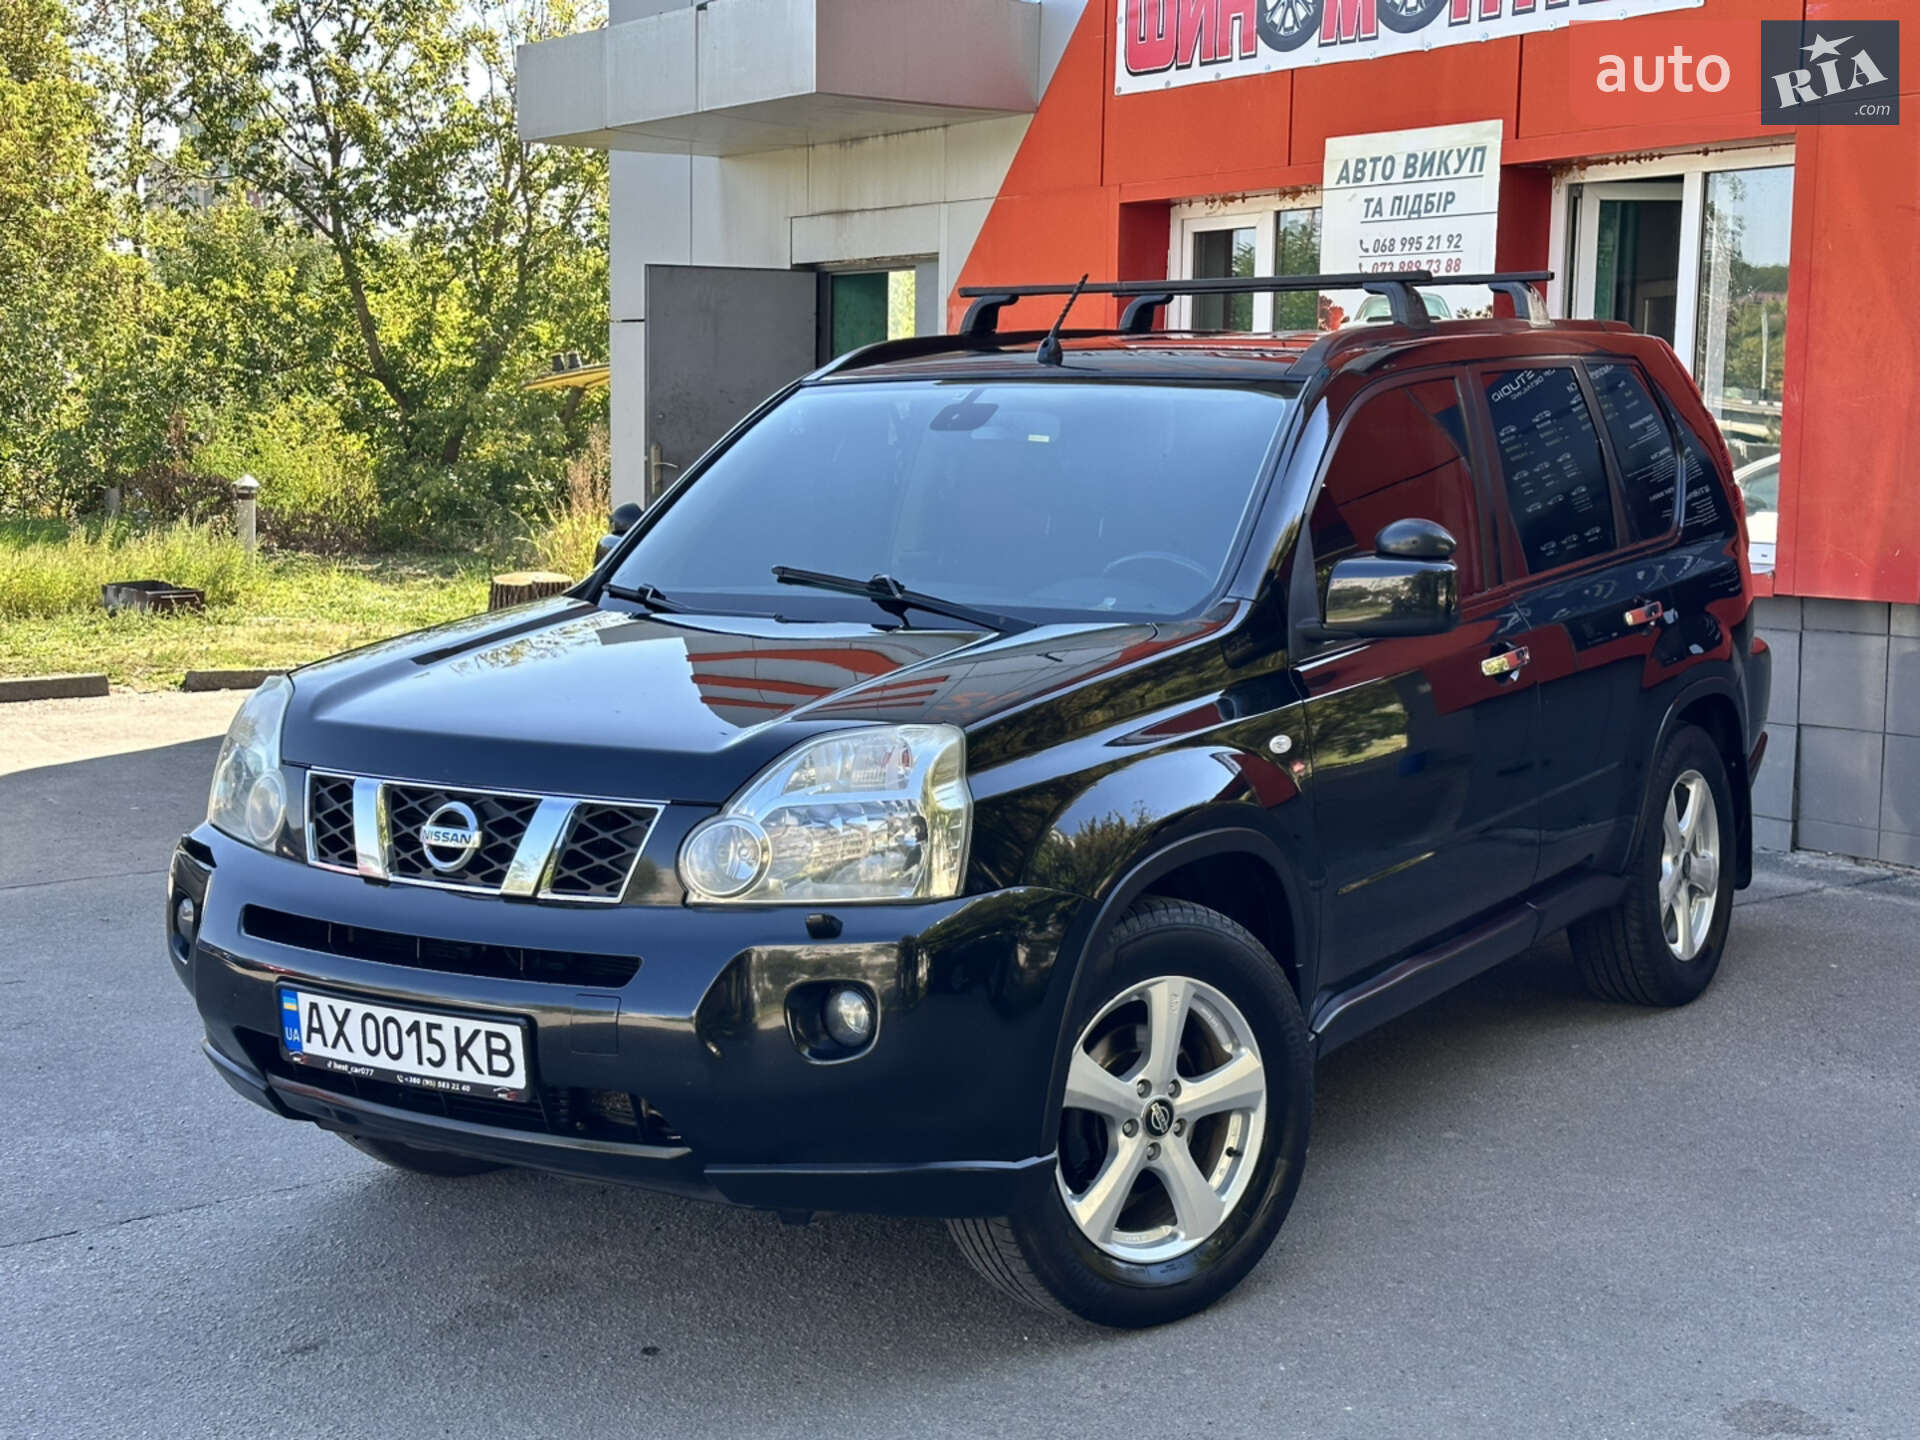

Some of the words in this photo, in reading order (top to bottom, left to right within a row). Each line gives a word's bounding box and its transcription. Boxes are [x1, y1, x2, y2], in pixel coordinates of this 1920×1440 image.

[1336, 155, 1396, 185] АВТО
[1402, 145, 1487, 180] ВИКУП
[1363, 197, 1383, 219] ТА
[1390, 191, 1456, 219] ПІДБІР
[1373, 238, 1396, 253] 068
[1400, 236, 1423, 252] 995
[1426, 234, 1442, 250] 21
[1447, 233, 1463, 249] 92
[1426, 259, 1441, 274] 73
[1445, 258, 1462, 273] 88
[423, 829, 472, 845] NISSAN
[285, 1027, 300, 1042] UA
